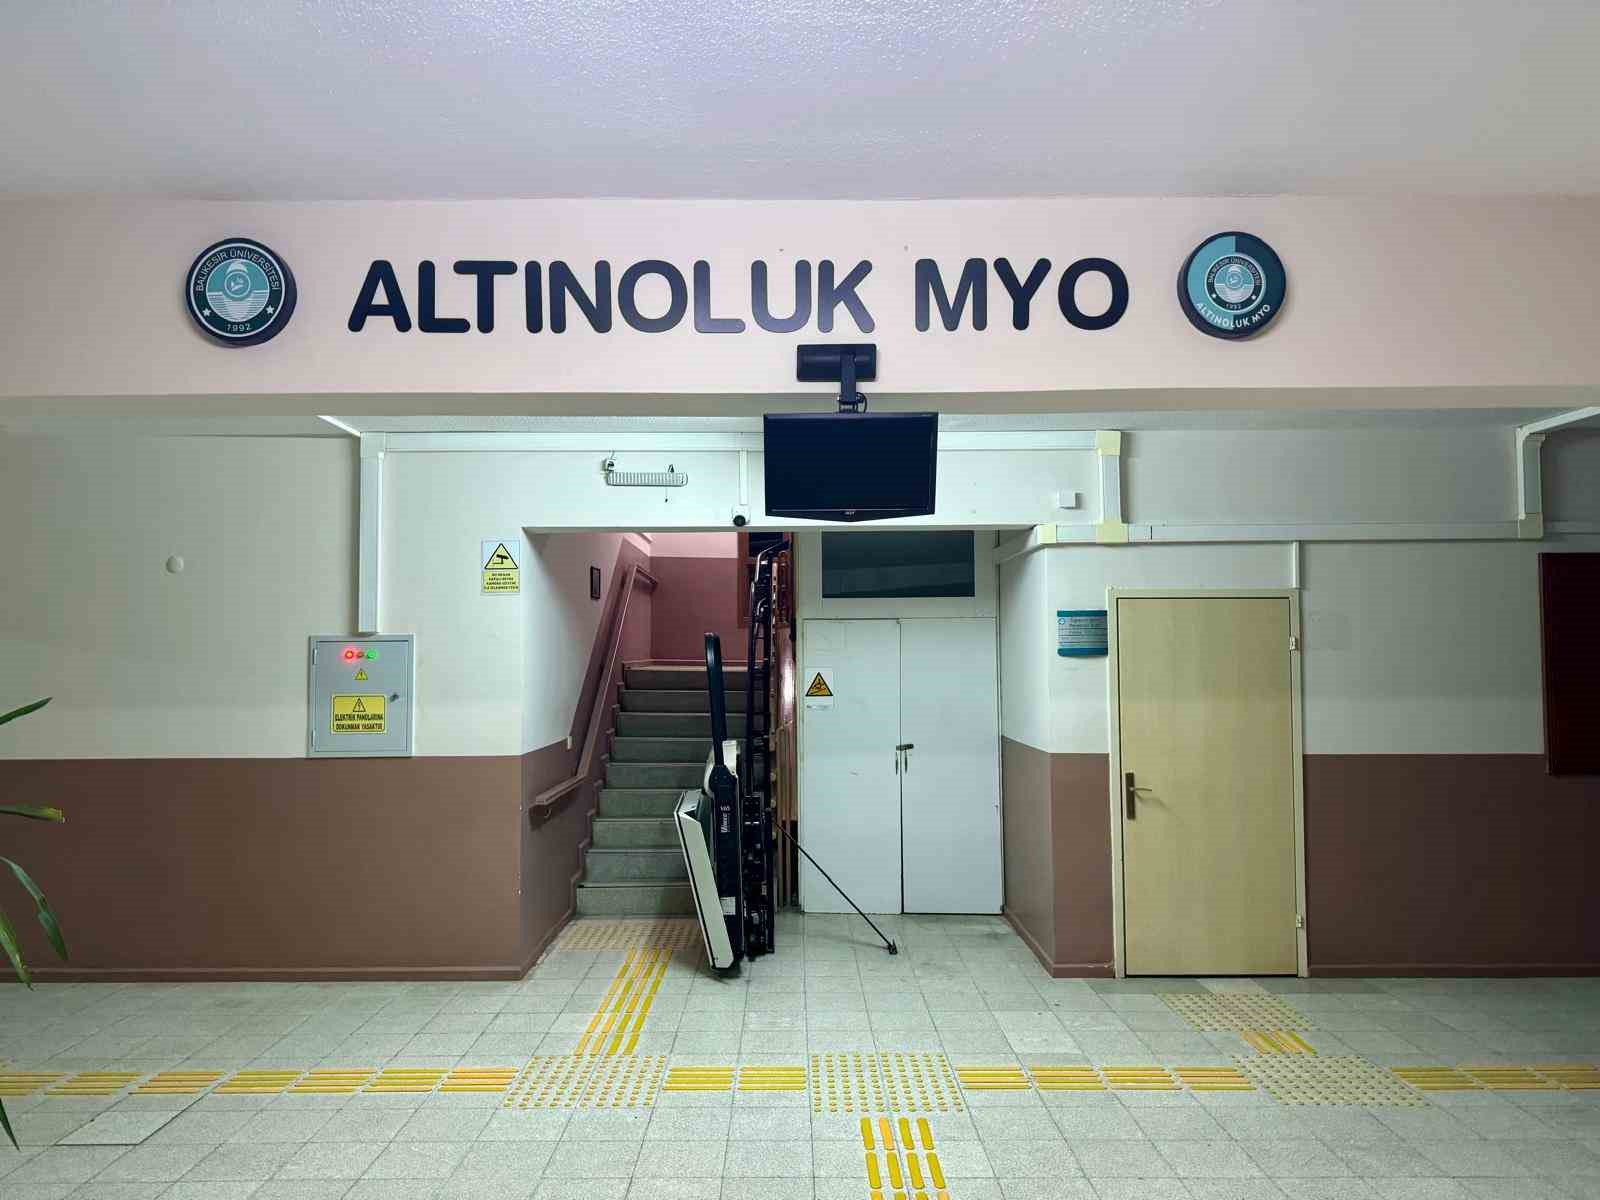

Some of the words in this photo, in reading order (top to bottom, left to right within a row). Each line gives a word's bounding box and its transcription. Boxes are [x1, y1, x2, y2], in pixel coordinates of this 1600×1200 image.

[347, 259, 875, 334] ALTINOLUK
[914, 257, 1129, 331] MYO
[1196, 302, 1251, 329] ALTINOLUK
[1251, 304, 1271, 323] MYO
